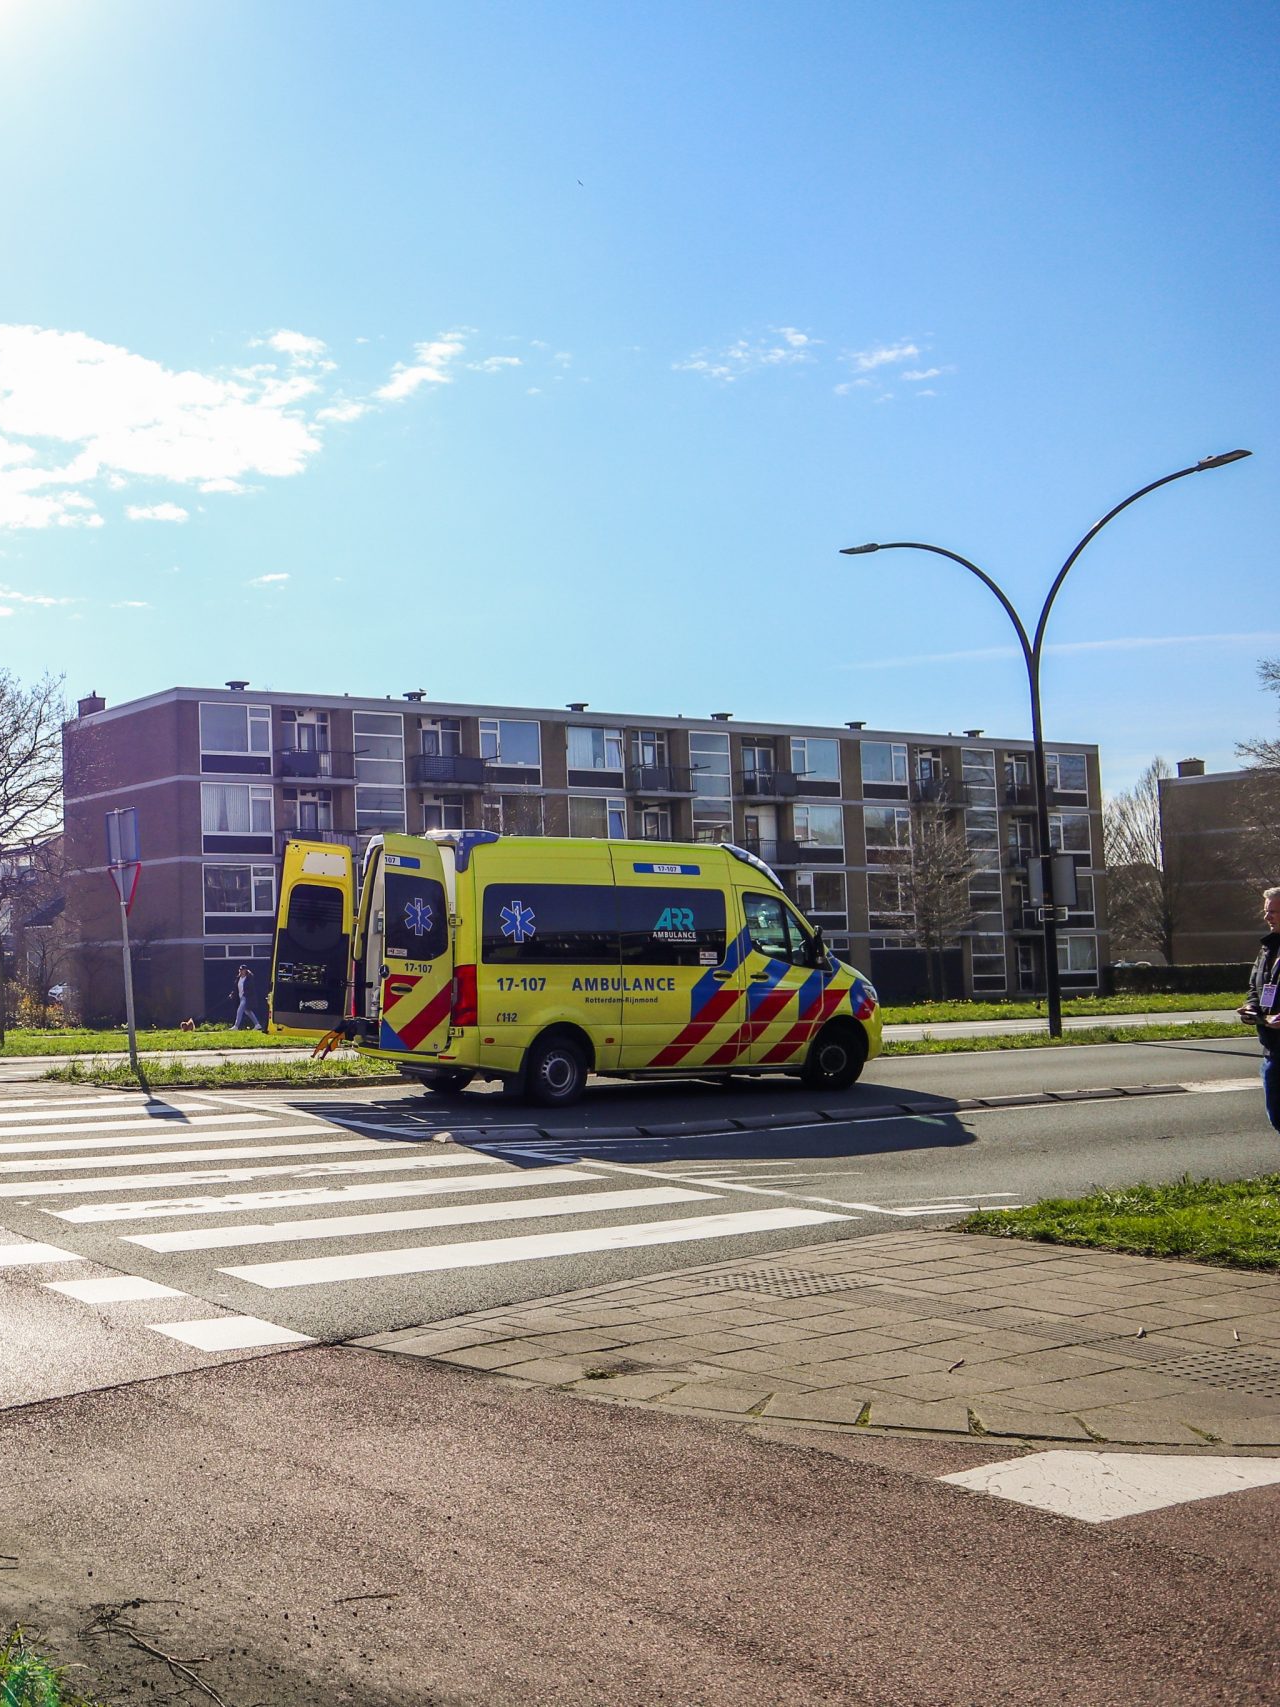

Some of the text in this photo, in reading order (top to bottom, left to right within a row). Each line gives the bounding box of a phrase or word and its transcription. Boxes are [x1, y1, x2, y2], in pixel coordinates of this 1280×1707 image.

[653, 907, 696, 931] ARR
[404, 963, 433, 973] 17-107
[497, 977, 547, 991] 17-107
[571, 977, 676, 991] AMBULANCE
[502, 1012, 518, 1023] 112
